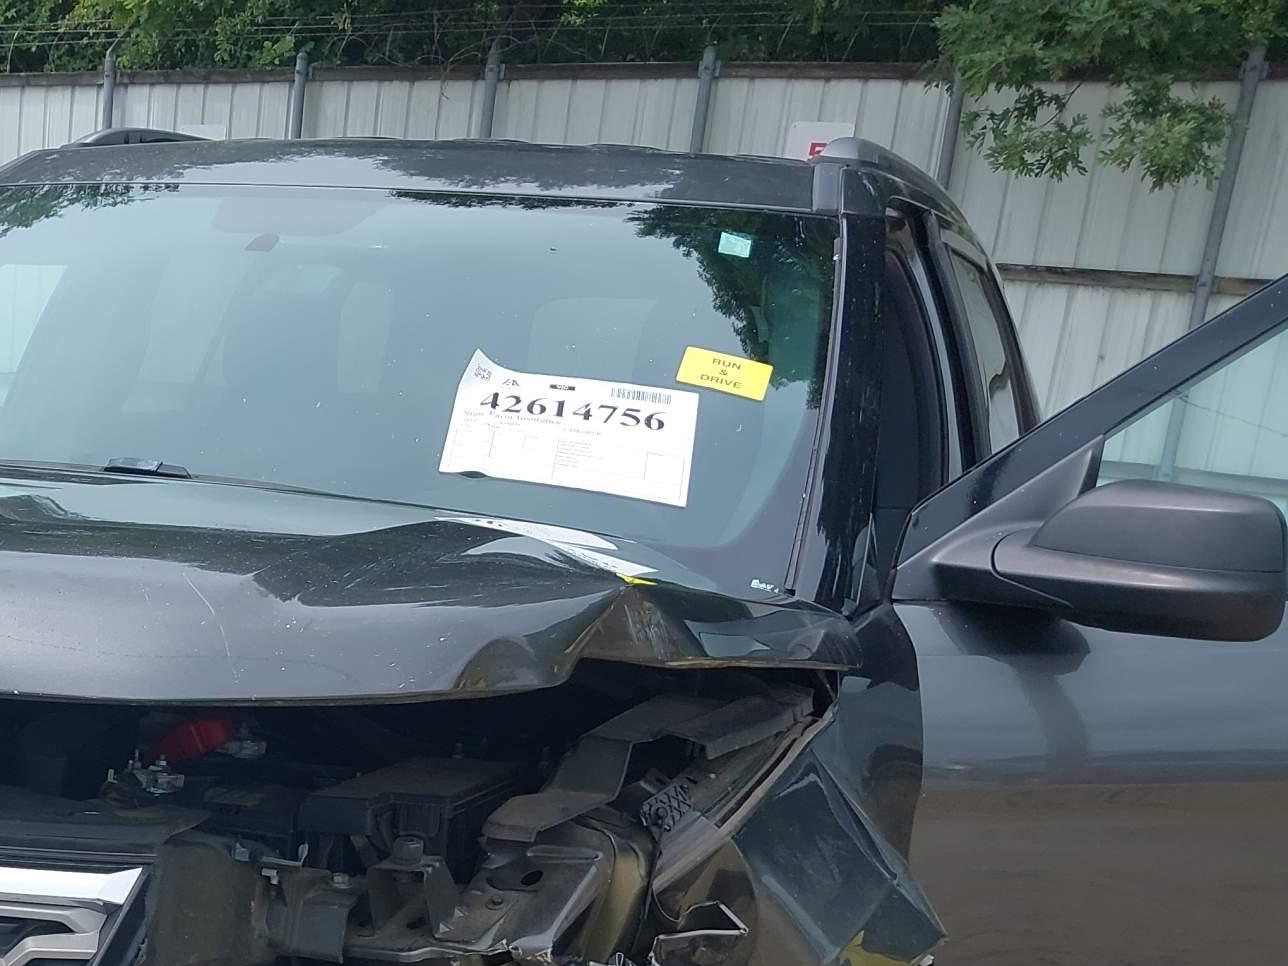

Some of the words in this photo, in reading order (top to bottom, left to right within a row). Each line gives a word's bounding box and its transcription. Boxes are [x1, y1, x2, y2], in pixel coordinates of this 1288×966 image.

[712, 358, 742, 370] RUN
[700, 374, 743, 389] DRIVE
[480, 391, 666, 431] 42614756
